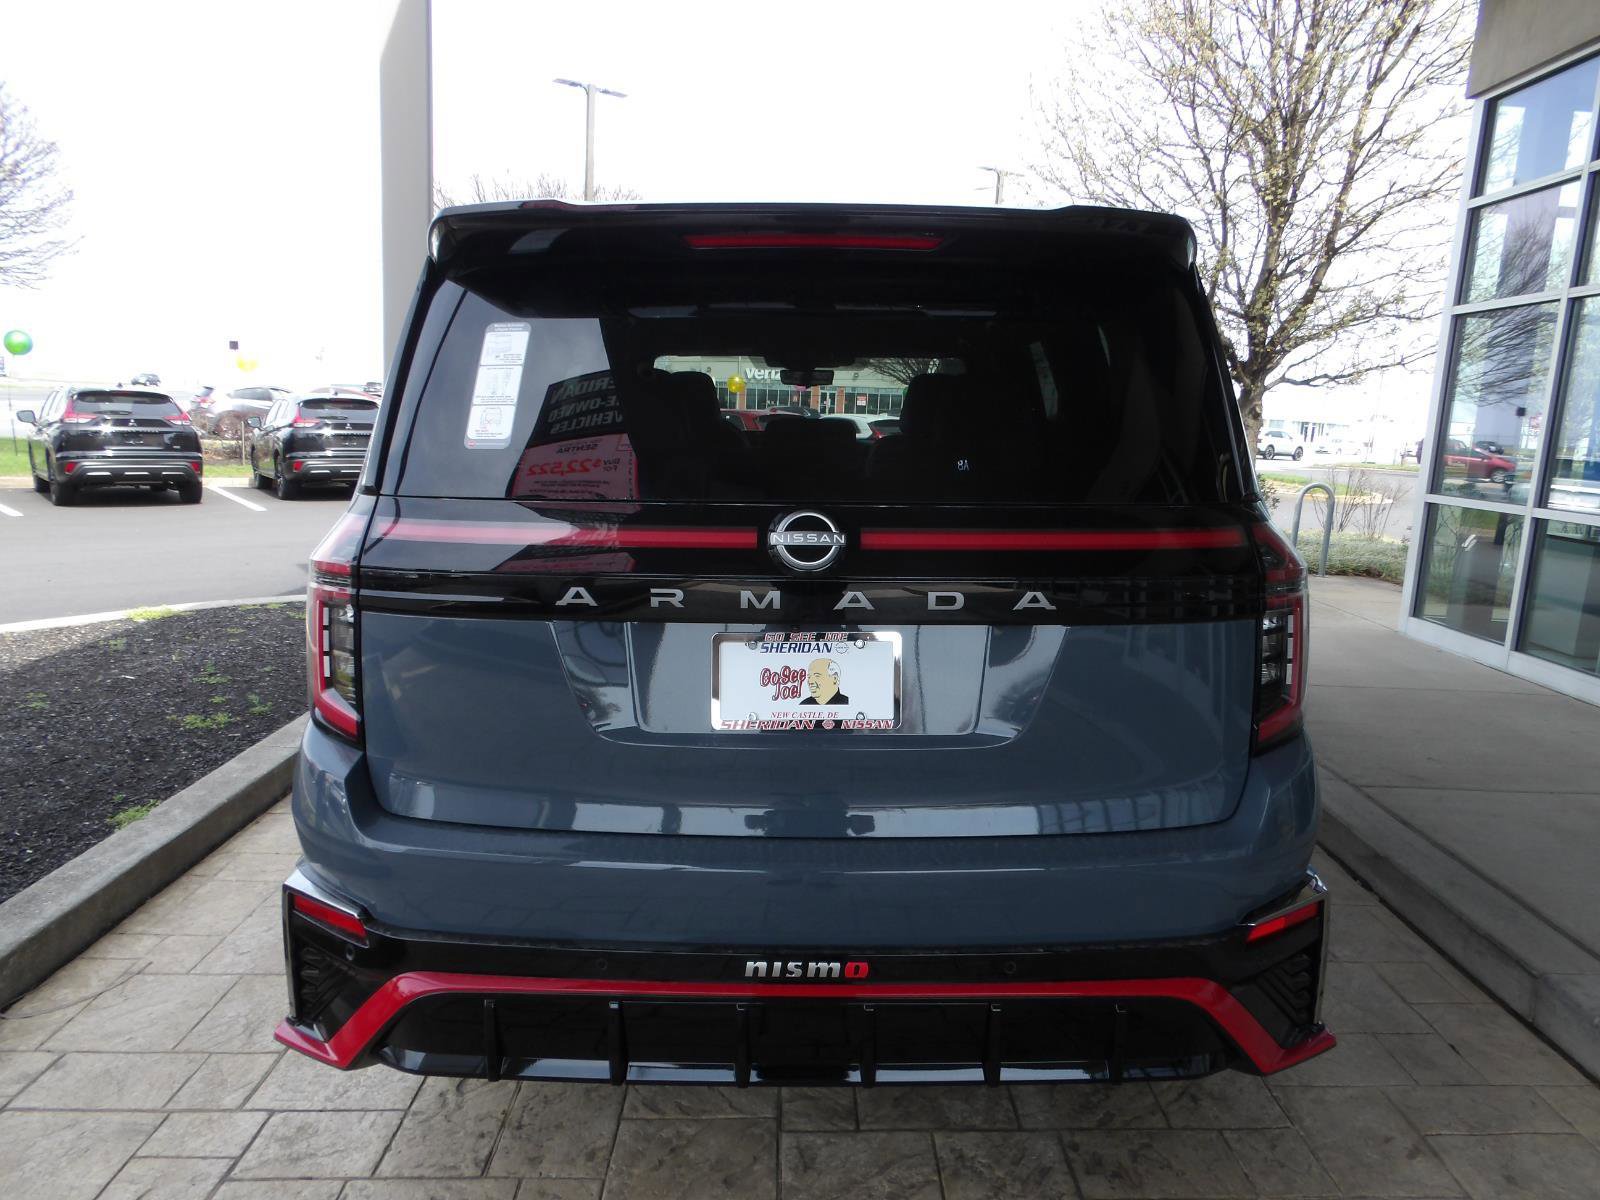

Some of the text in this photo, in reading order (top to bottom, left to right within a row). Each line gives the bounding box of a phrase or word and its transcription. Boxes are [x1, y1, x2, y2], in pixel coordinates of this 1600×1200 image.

[772, 533, 846, 543] NISSAN
[555, 586, 1057, 611] ARMADA
[789, 632, 816, 642] SEE
[820, 632, 848, 642] JOE
[760, 642, 833, 653] SHERIDAN
[760, 667, 779, 687] Go
[770, 711, 790, 719] NEW
[827, 711, 839, 719] DE
[720, 720, 894, 730] SHERIDAN NISSAN
[744, 961, 869, 978] nismo
